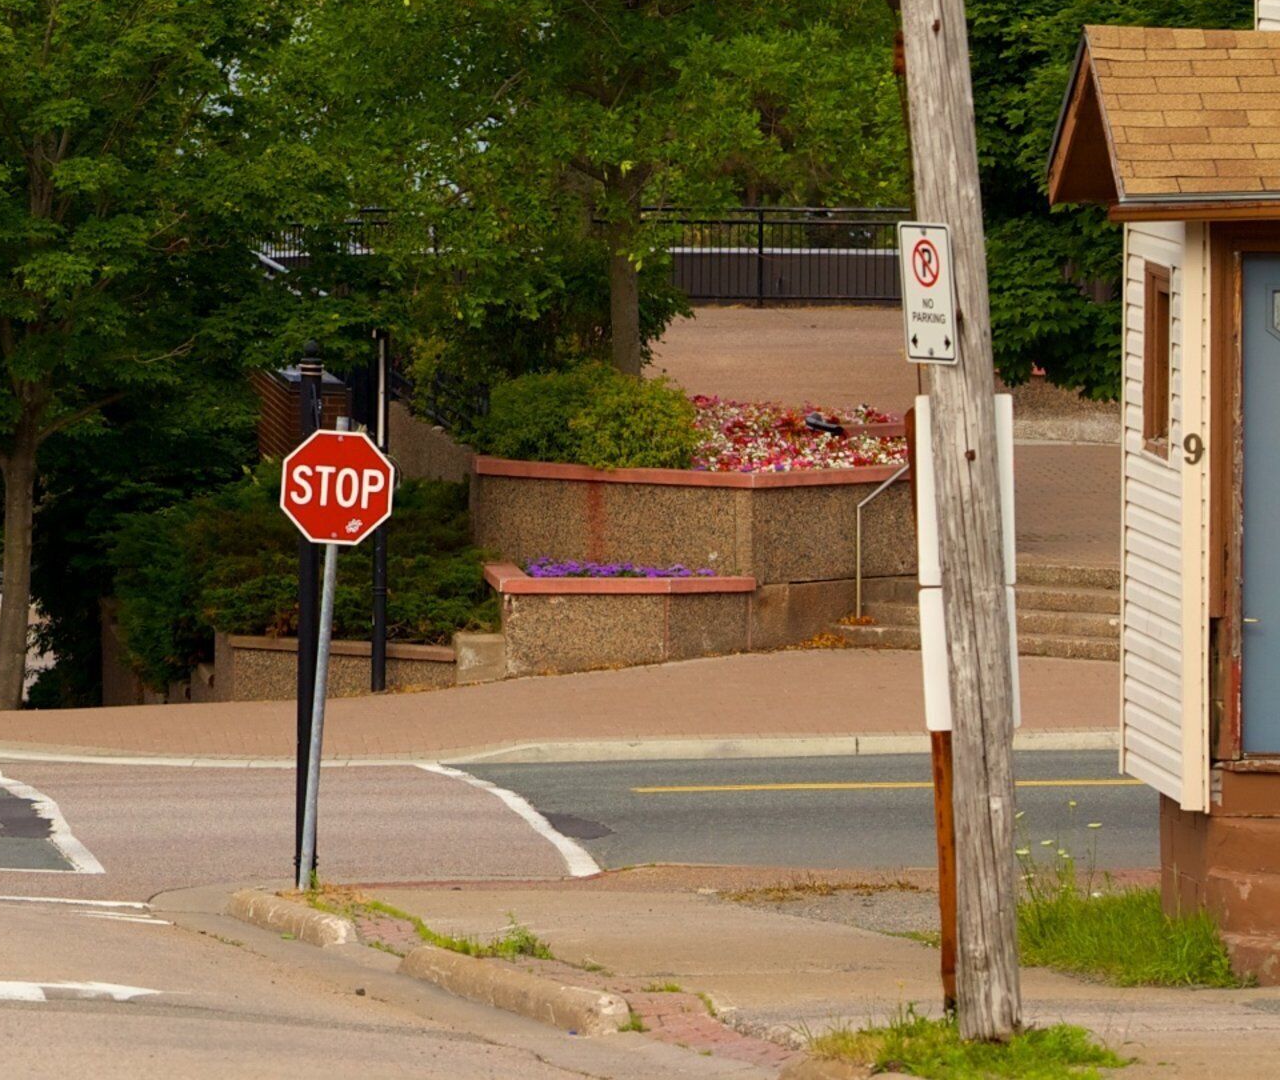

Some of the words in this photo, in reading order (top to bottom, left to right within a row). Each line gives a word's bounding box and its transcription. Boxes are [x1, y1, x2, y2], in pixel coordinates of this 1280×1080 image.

[922, 298, 934, 309] NO
[912, 312, 946, 324] PARKING
[1183, 433, 1204, 465] 9
[290, 465, 385, 509] STOP
